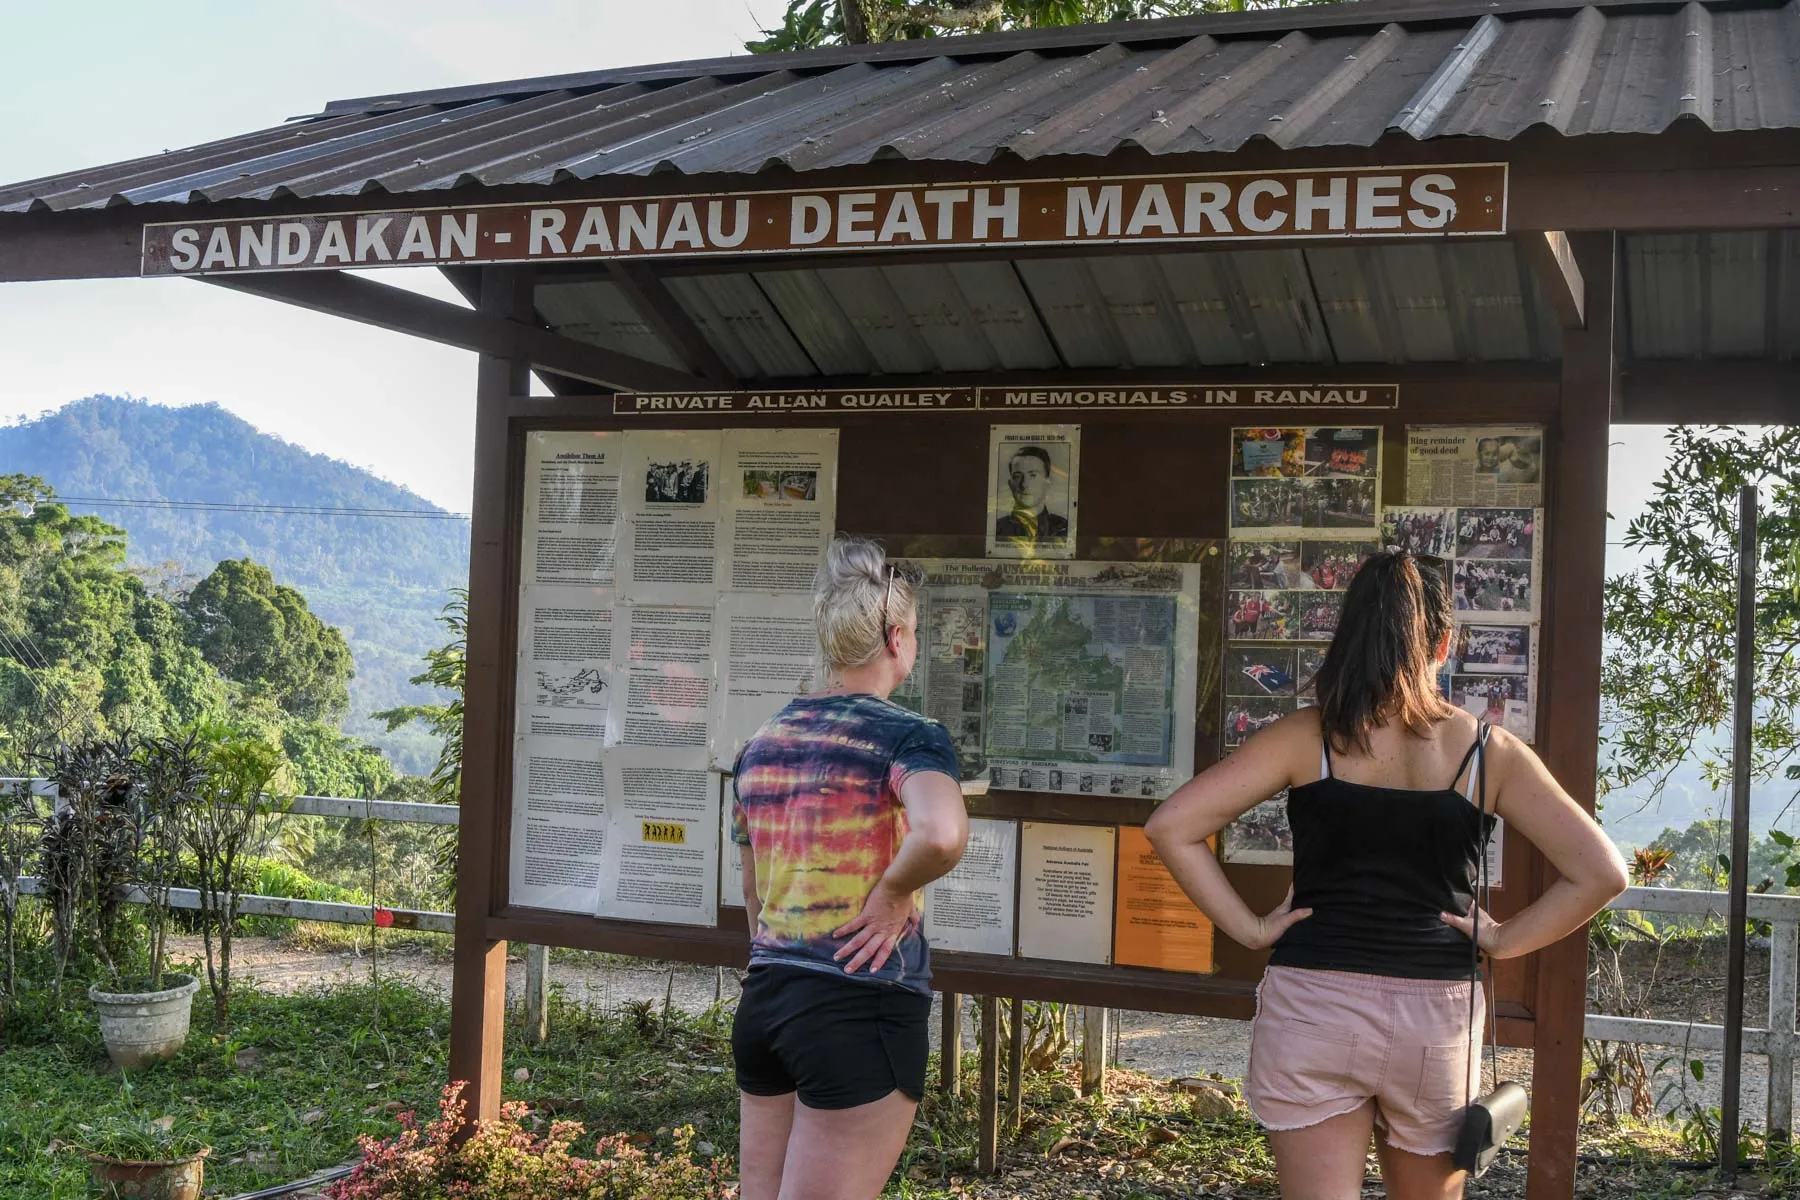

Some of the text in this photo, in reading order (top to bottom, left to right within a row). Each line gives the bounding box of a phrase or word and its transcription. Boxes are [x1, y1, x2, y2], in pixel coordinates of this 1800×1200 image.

[170, 213, 478, 270] SANDAKAN
[528, 199, 750, 255] RANAU
[790, 186, 1020, 245] DEATH
[1065, 173, 1457, 237] MARCHES
[635, 392, 952, 410] PRIVATE ALLAN QUAILEY
[1004, 389, 1368, 405] MEMORIALS IN RANAU
[1430, 437, 1466, 445] reminder
[1420, 446, 1439, 455] good
[1440, 446, 1459, 454] deed
